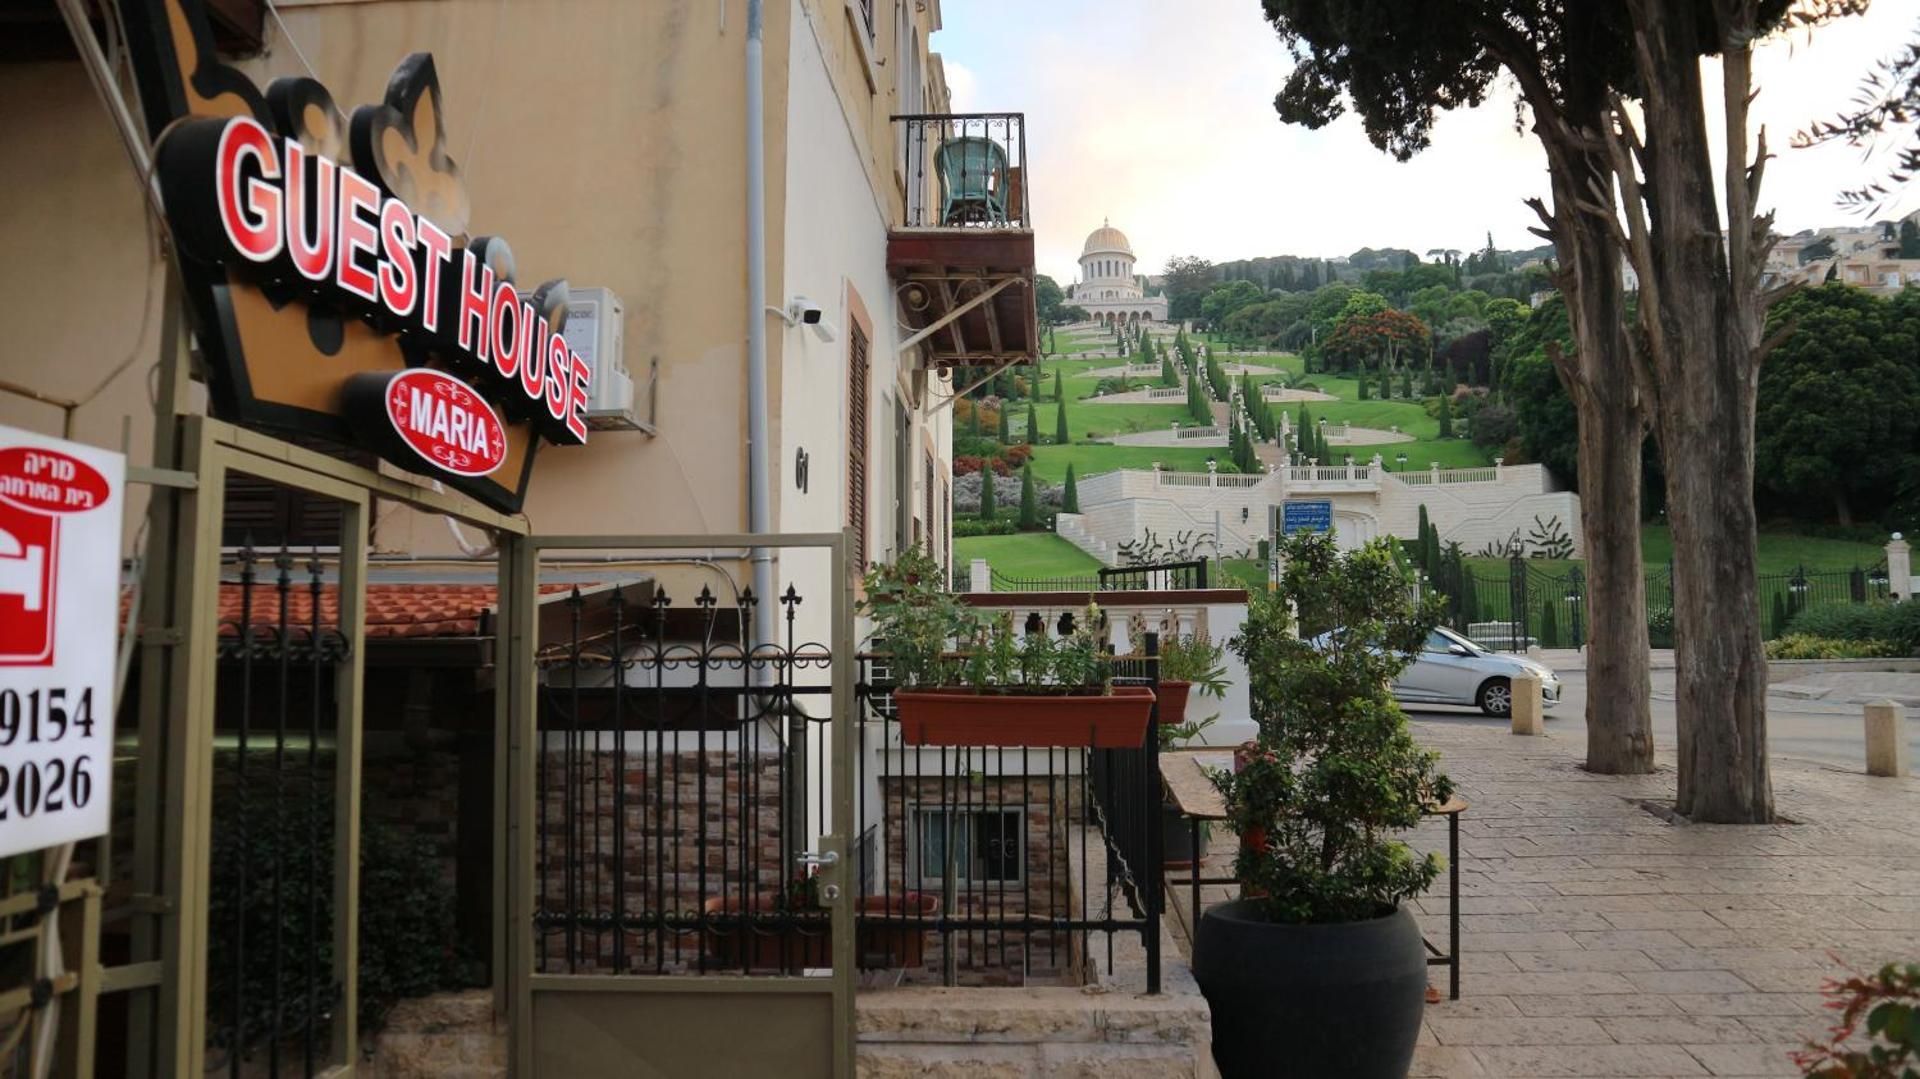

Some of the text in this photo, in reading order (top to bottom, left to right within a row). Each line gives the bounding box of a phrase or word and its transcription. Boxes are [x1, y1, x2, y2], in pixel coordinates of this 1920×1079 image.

[216, 115, 591, 444] GUEST HOUSE
[410, 387, 489, 459] MARIA
[24, 452, 76, 482] מריה
[64, 487, 93, 508] בית
[0, 686, 94, 746] 9154
